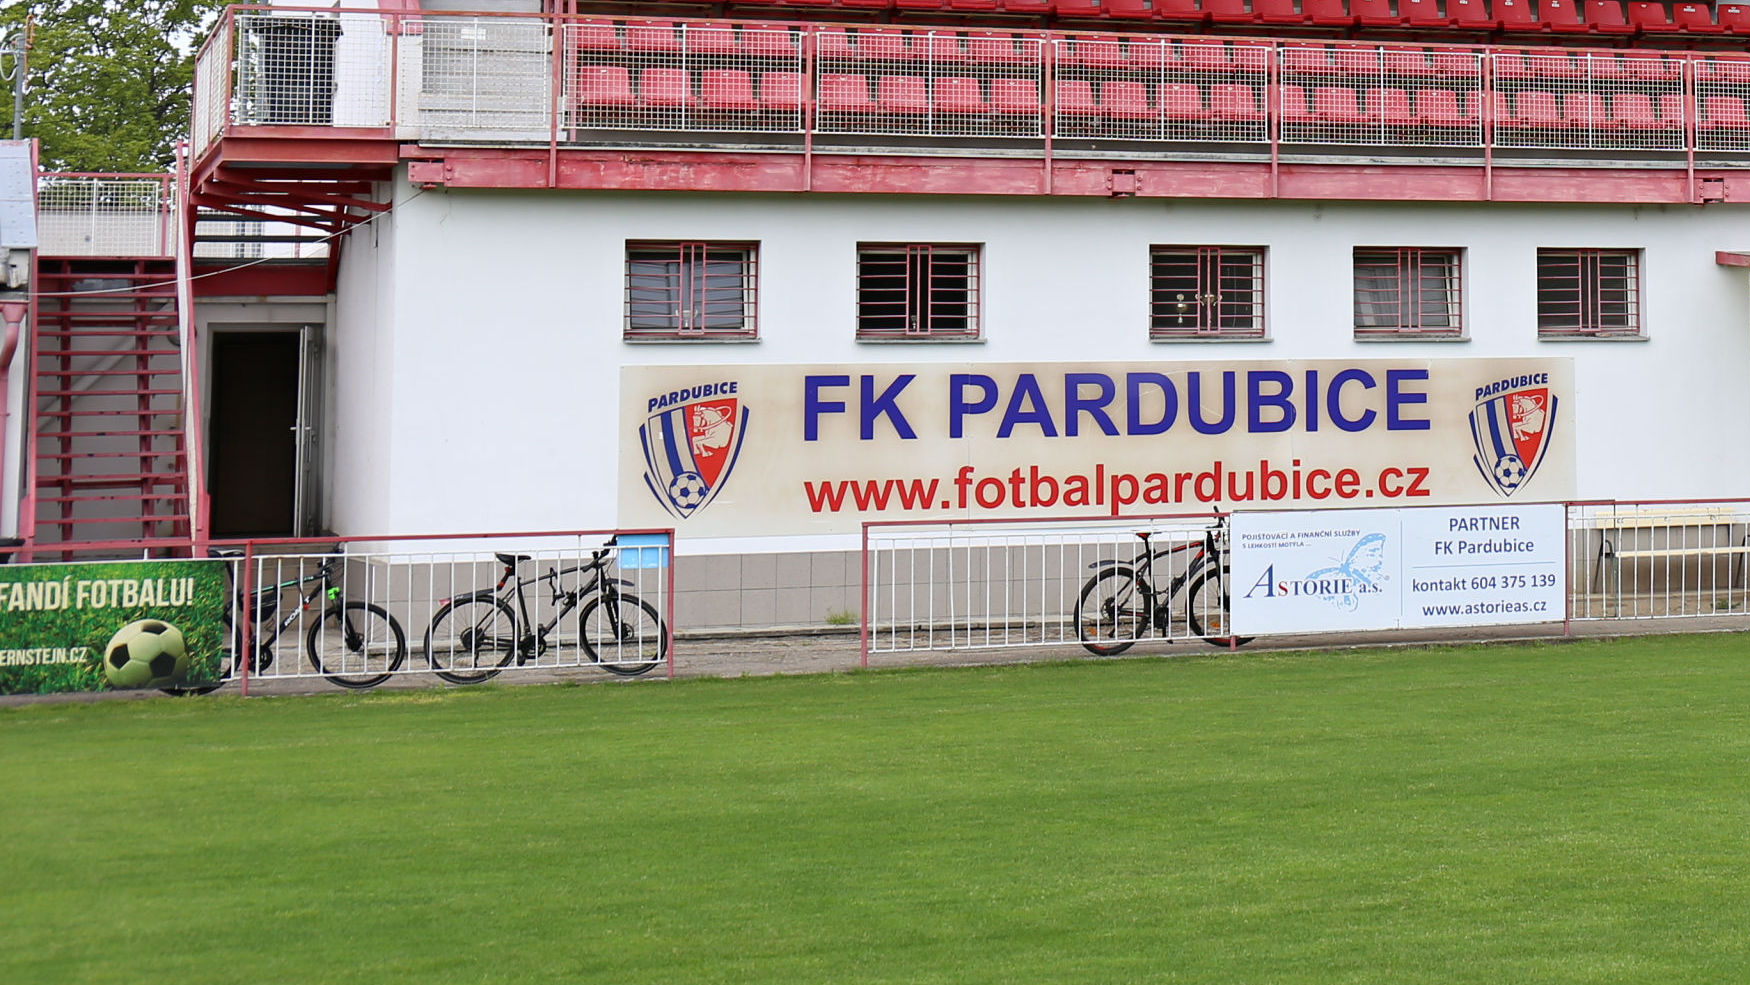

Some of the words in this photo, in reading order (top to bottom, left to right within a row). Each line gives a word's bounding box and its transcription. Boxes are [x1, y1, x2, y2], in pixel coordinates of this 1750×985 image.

[1475, 372, 1549, 402] PARDUBICE
[647, 381, 738, 413] PARDUBICE
[804, 374, 918, 442] FK
[949, 368, 1431, 439] PARDUBICE
[804, 459, 1431, 515] www.fotbalpardubice.cz
[1449, 516, 1520, 532] PARTNER
[1334, 529, 1361, 538] SLUŽBY
[1434, 541, 1453, 555] FK
[1458, 538, 1534, 554] Pardubice
[1359, 581, 1383, 594] a.s.
[1412, 576, 1467, 592] kontakt
[1471, 576, 1497, 590] 604
[1501, 575, 1526, 589] 375
[1531, 574, 1556, 588] 139
[76, 577, 194, 610] FOTBALU!
[1422, 599, 1547, 616] www.astorieas.cz
